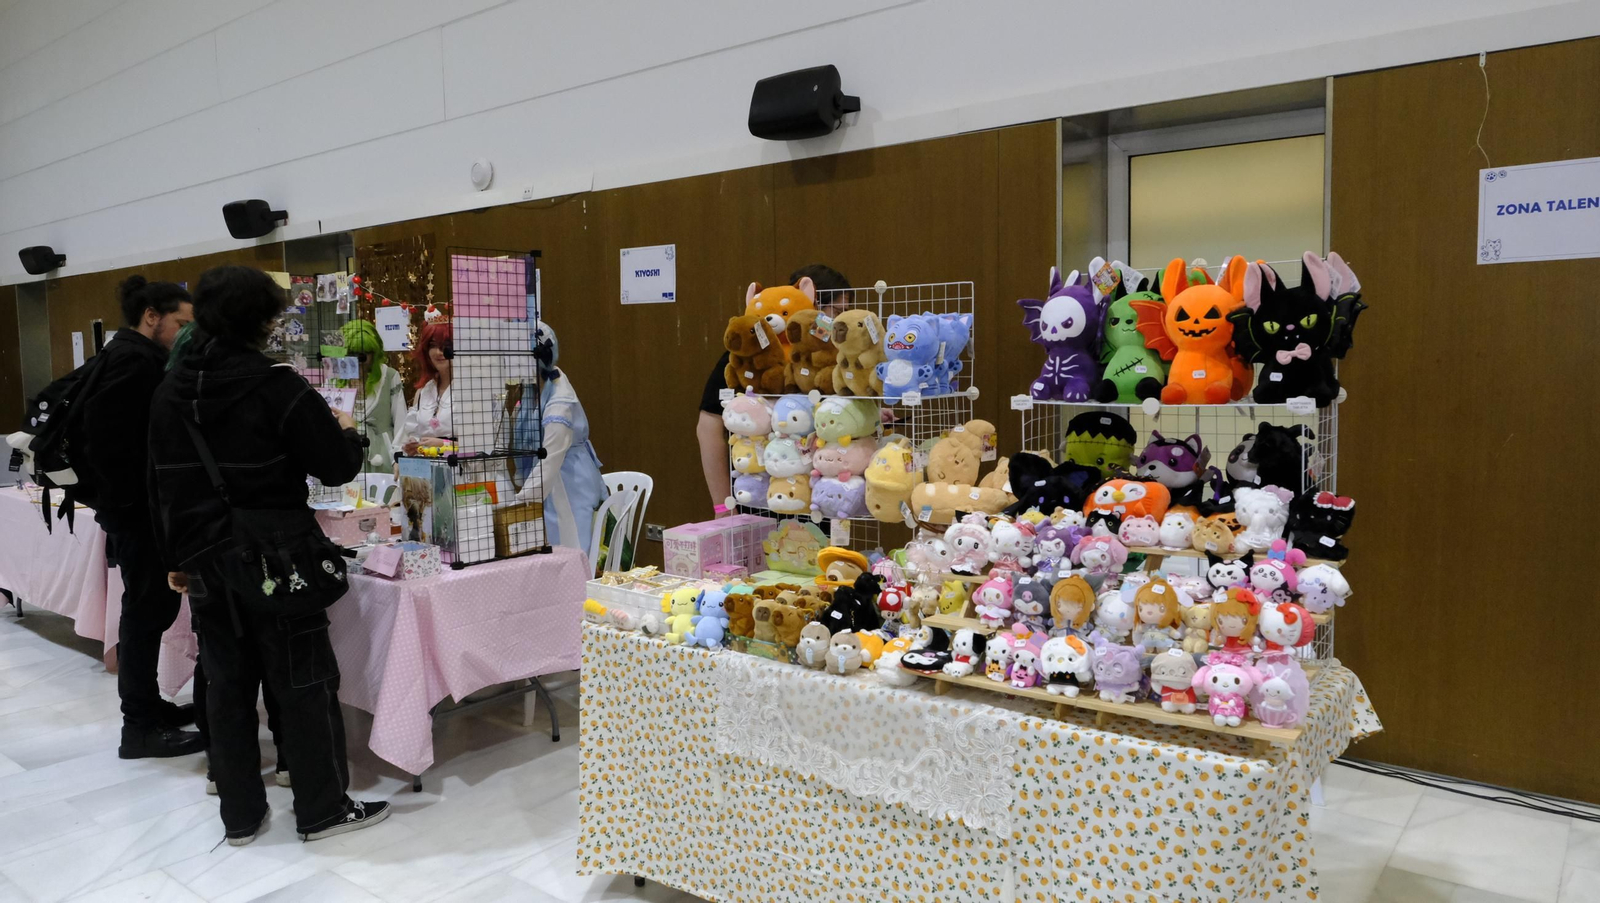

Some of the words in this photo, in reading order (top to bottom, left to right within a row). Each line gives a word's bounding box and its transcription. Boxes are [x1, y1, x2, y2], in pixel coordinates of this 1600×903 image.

[1496, 202, 1541, 216] ZONA
[1546, 196, 1600, 212] TALEN
[635, 269, 660, 277] KIYOSHI
